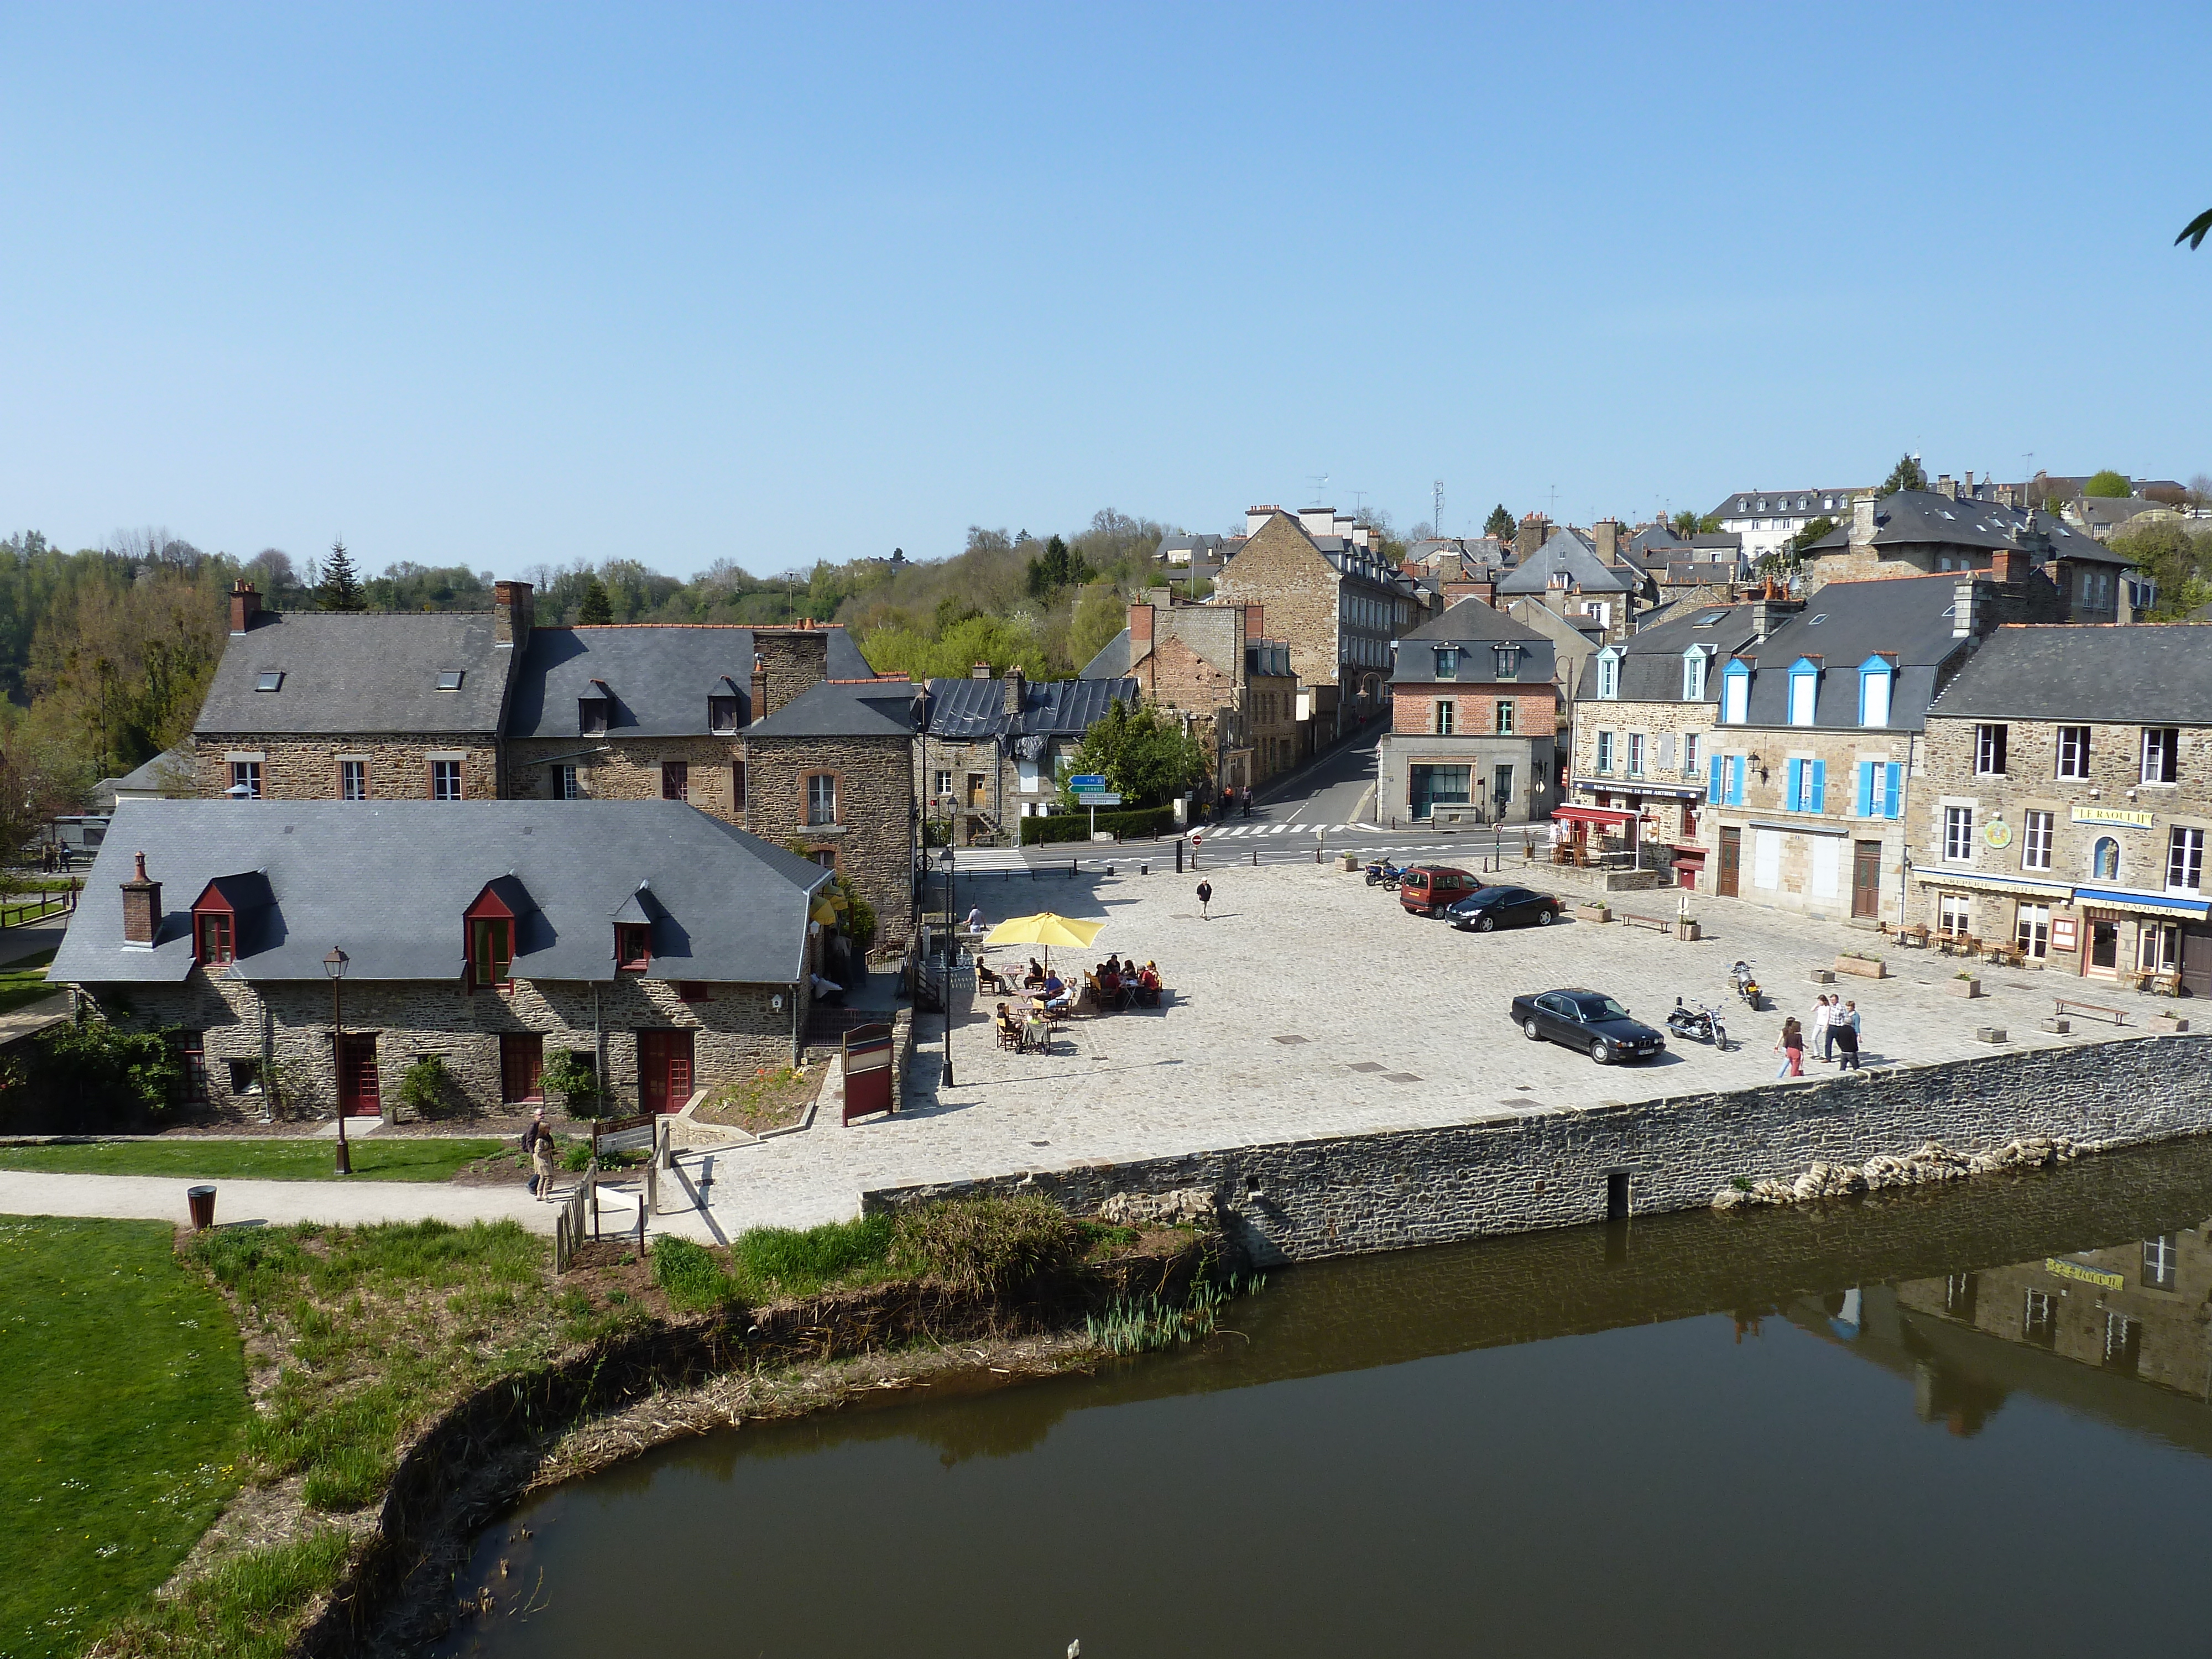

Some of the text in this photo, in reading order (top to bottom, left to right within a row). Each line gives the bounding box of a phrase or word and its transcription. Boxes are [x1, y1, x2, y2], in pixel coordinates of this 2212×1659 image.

[1593, 785, 1632, 793] BAR-BRASSERIE
[2074, 808, 2093, 818] "LE
[2096, 810, 2133, 821] RAOUL
[2123, 903, 2162, 912] RAOUL
